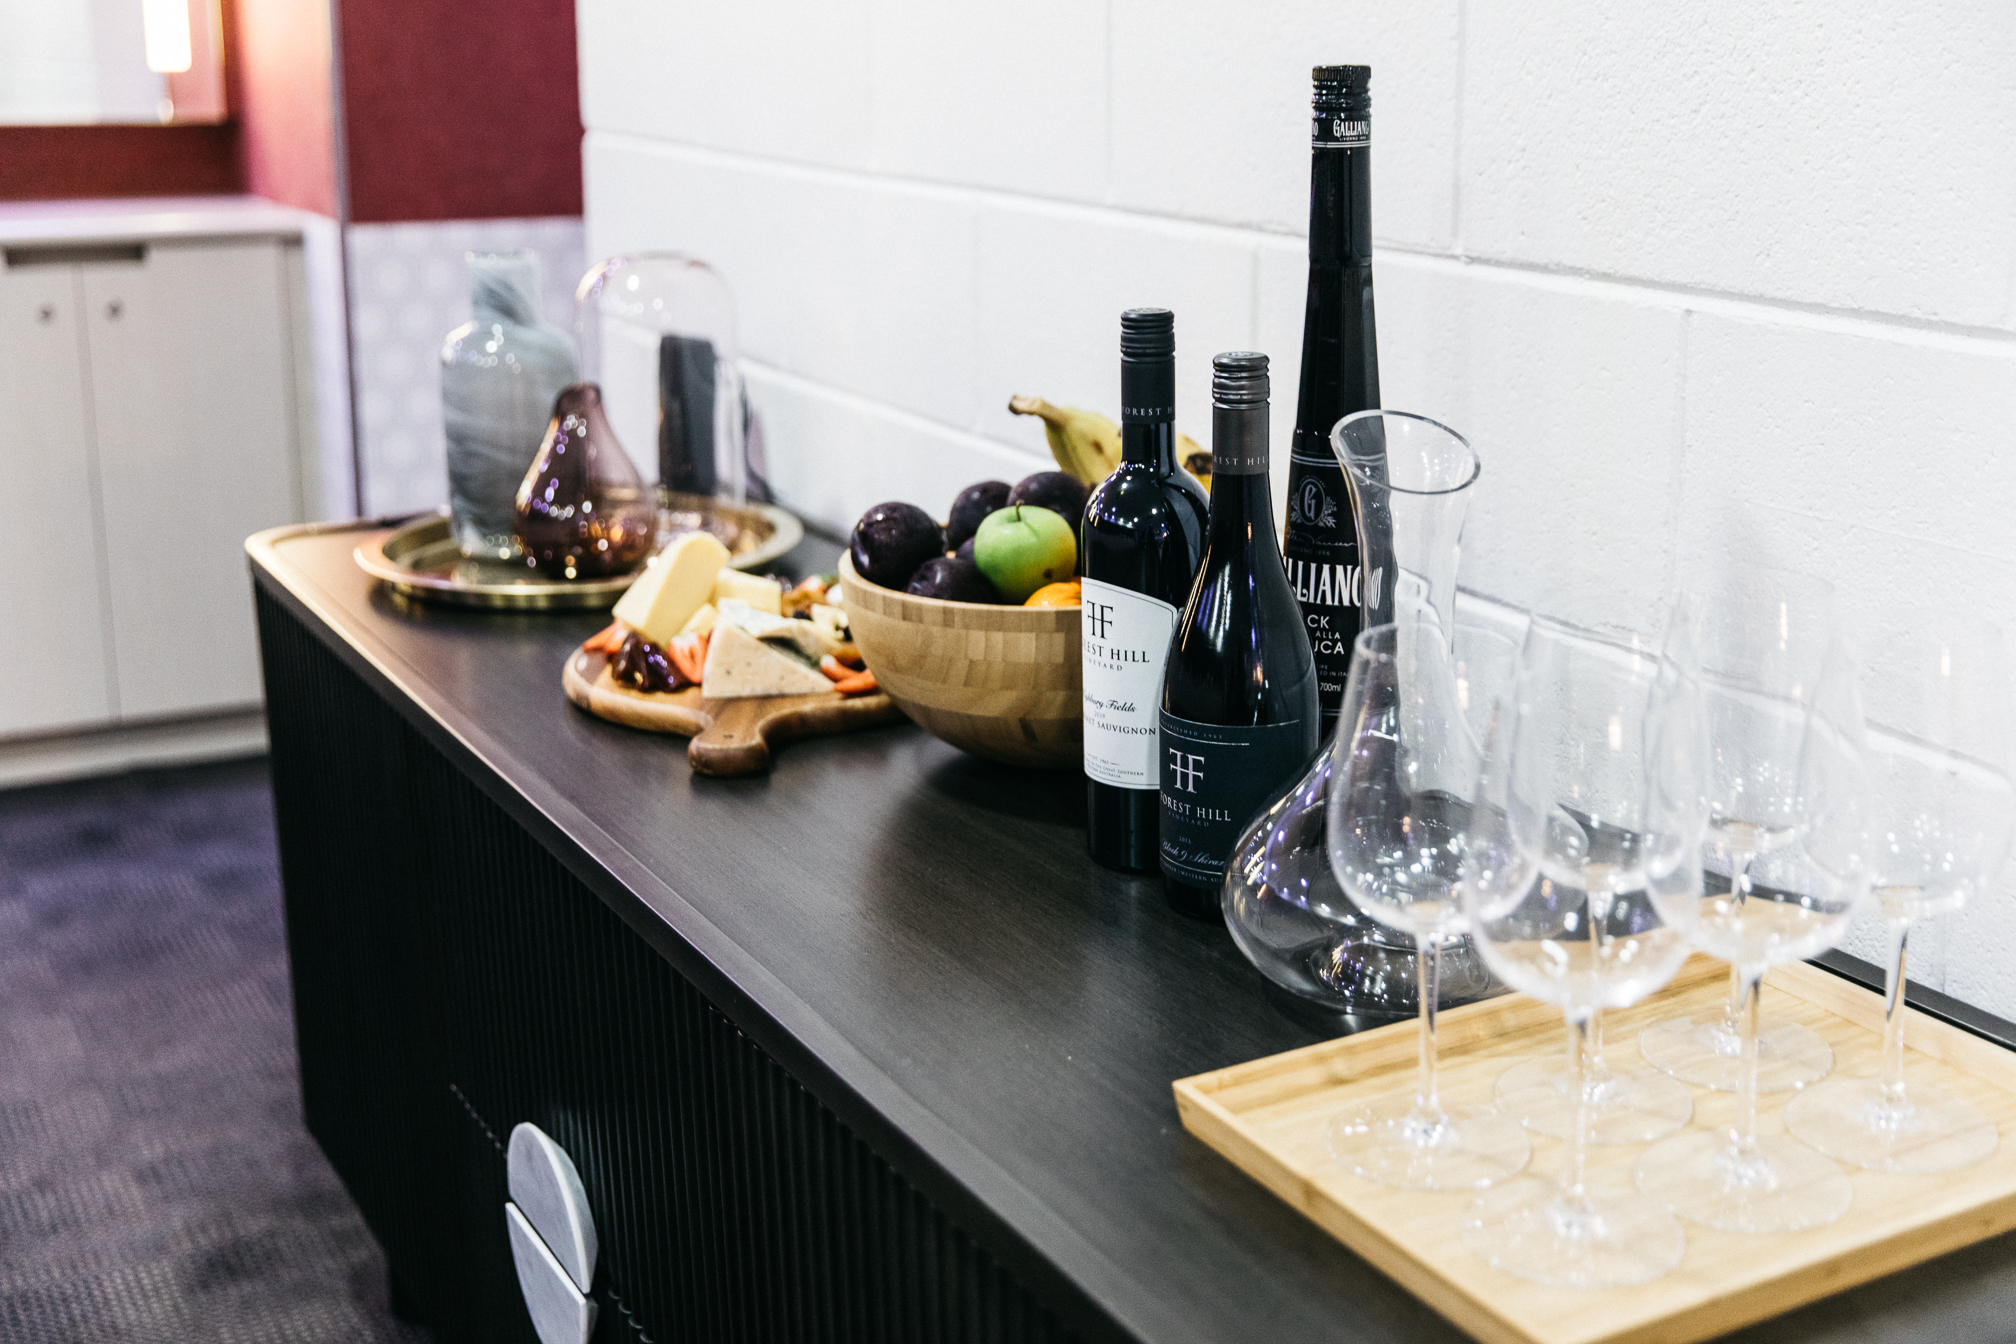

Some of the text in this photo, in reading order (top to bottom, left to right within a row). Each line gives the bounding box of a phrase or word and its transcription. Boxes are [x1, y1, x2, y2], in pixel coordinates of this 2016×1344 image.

[1247, 455, 1268, 466] HIL
[1315, 630, 1341, 640] ALLA
[1110, 648, 1150, 663] HILL
[1319, 682, 1342, 692] 700ml
[1106, 699, 1136, 712] Fields
[1097, 721, 1156, 736] SAUVIGNON
[1168, 810, 1210, 827] VINEYARD
[1196, 806, 1231, 822] HILL
